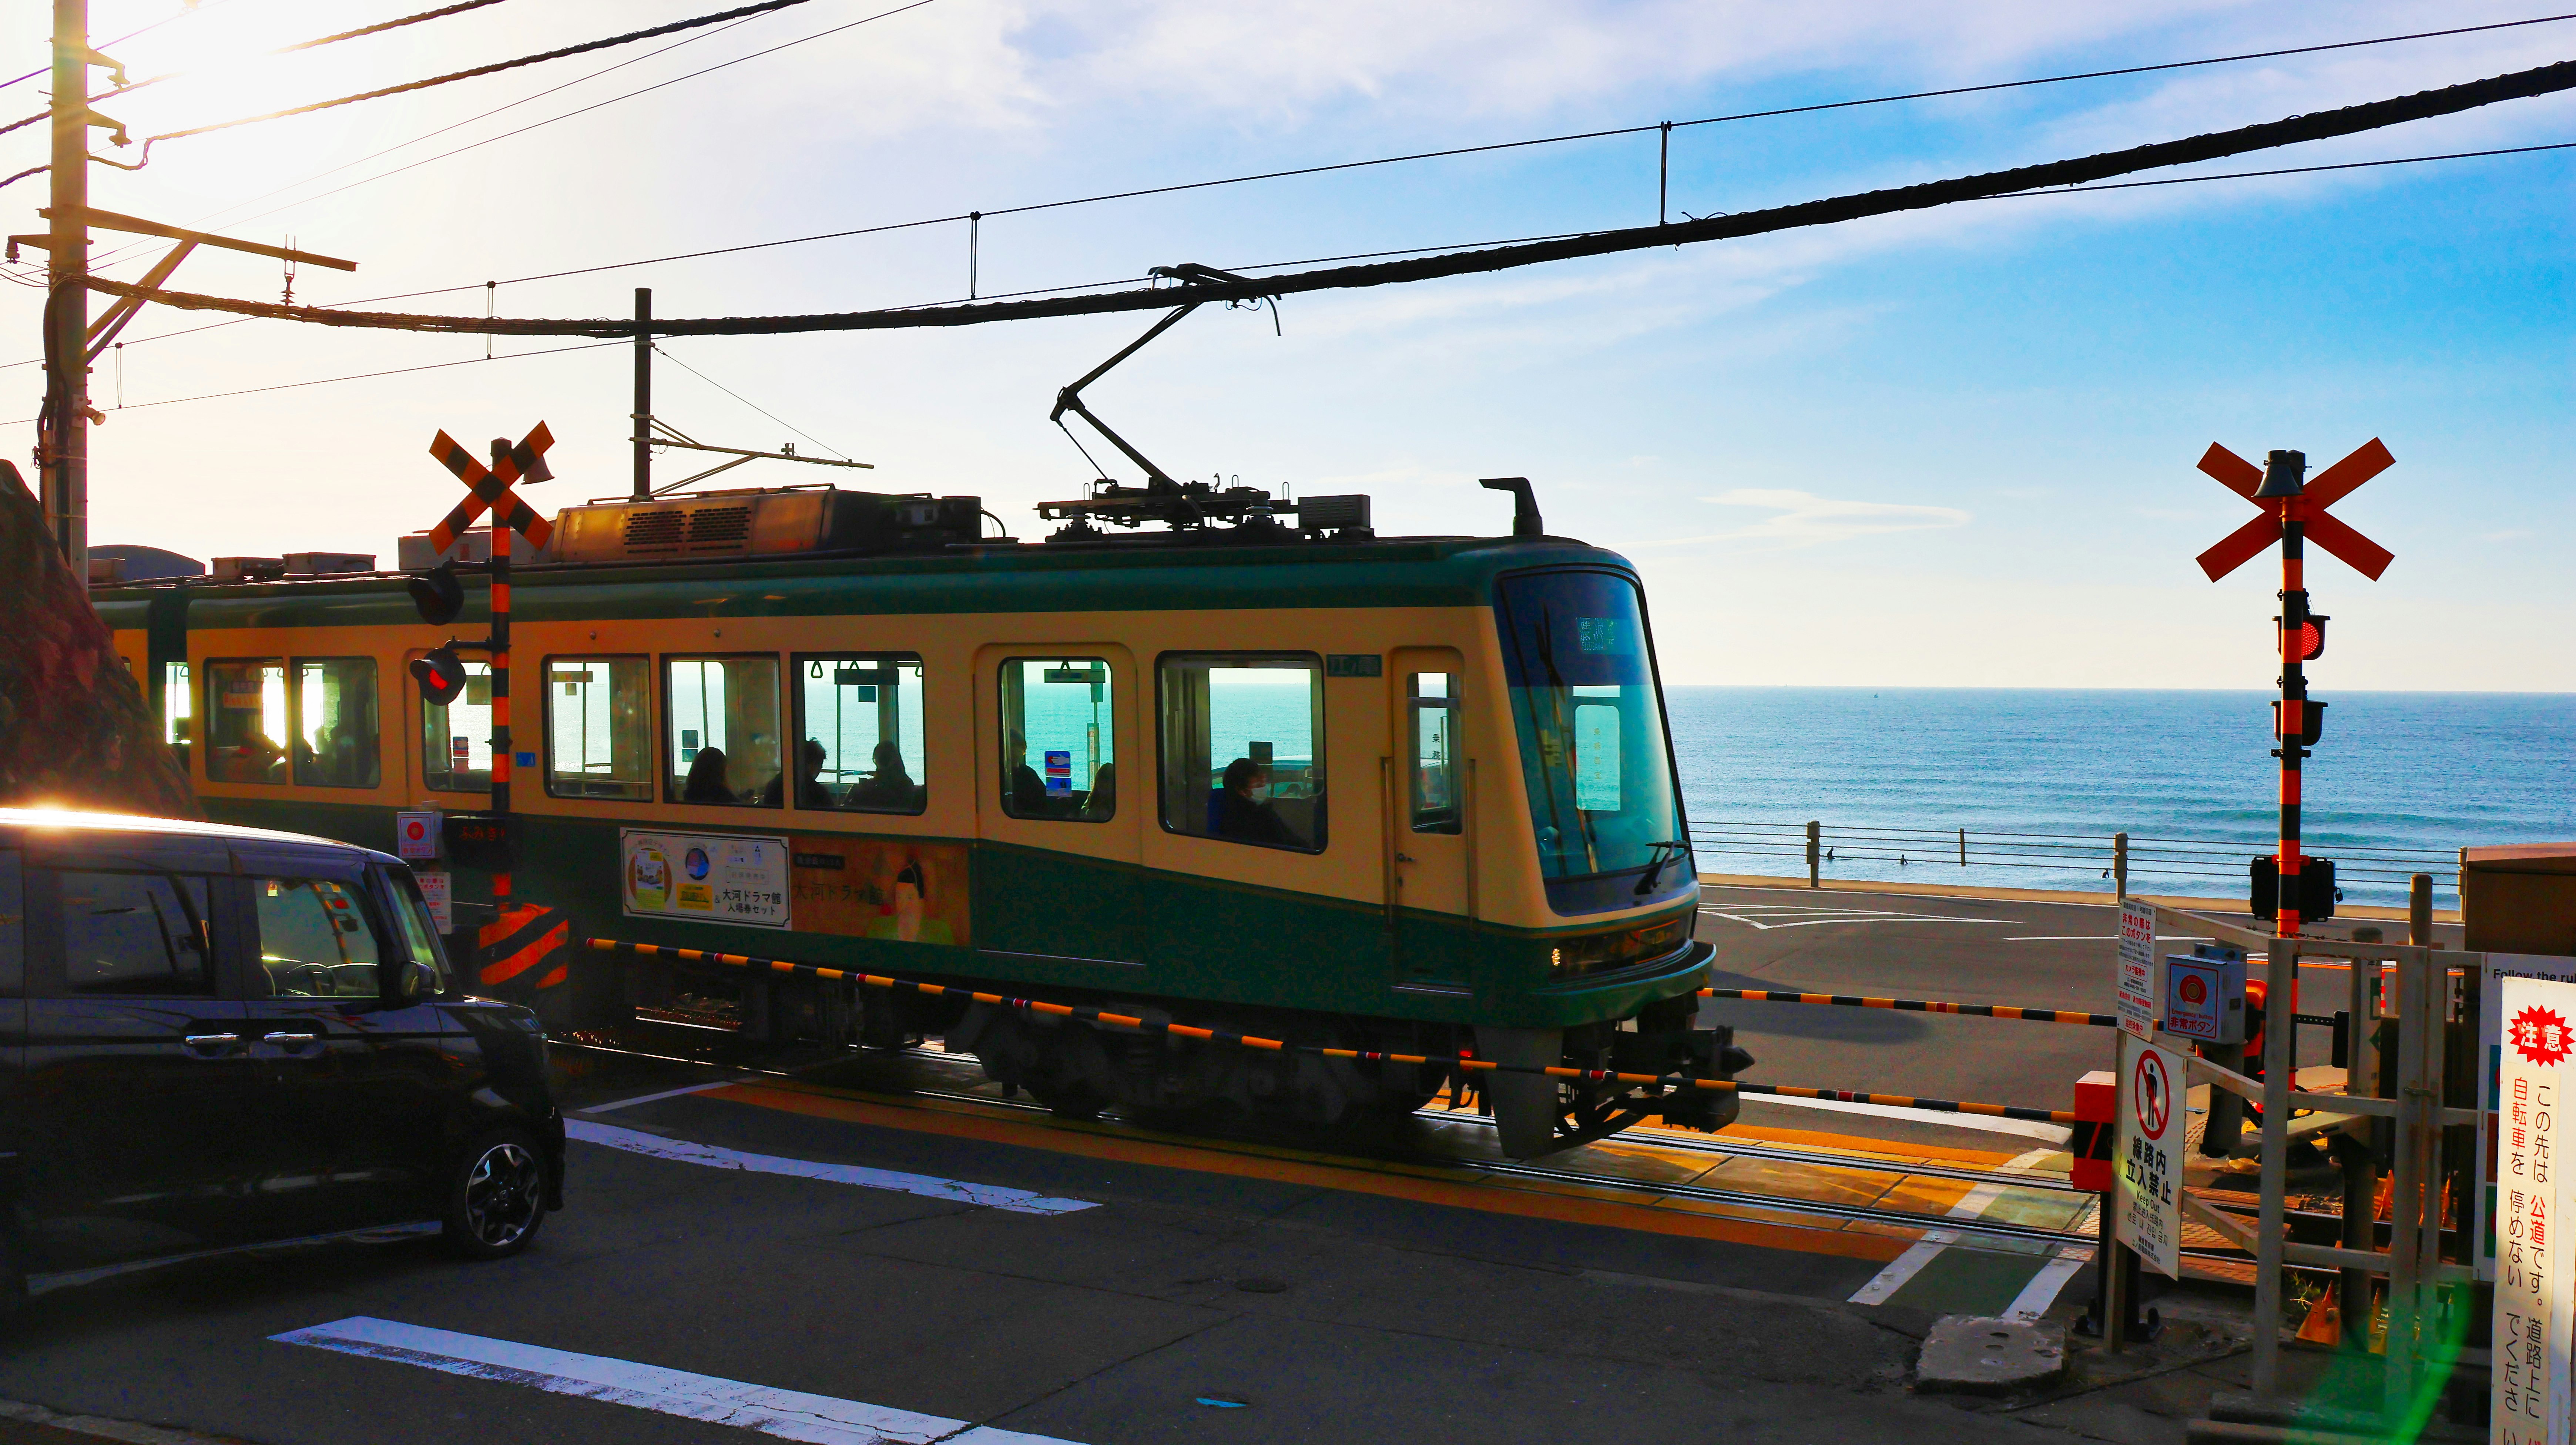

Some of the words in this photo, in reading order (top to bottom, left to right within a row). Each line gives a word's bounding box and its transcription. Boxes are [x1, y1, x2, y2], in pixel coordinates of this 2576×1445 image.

[722, 889, 781, 905] 大河ドラマ館
[727, 902, 776, 916] 入場券セット
[2122, 912, 2150, 930] 非常の際は
[2121, 925, 2151, 944] このボタンを
[2493, 969, 2533, 979] Follow
[2536, 971, 2557, 982] the
[2171, 1008, 2196, 1019] Emergency
[2170, 1016, 2215, 1033] 非常ボタン
[2520, 1020, 2562, 1052] 注意
[2133, 1134, 2166, 1176] 線路内
[2126, 1158, 2171, 1206] 立入禁止
[2137, 1190, 2149, 1208] Keep
[2150, 1199, 2160, 1213] Out
[2147, 1223, 2156, 1238] 진입
[2158, 1231, 2168, 1247] 금지
